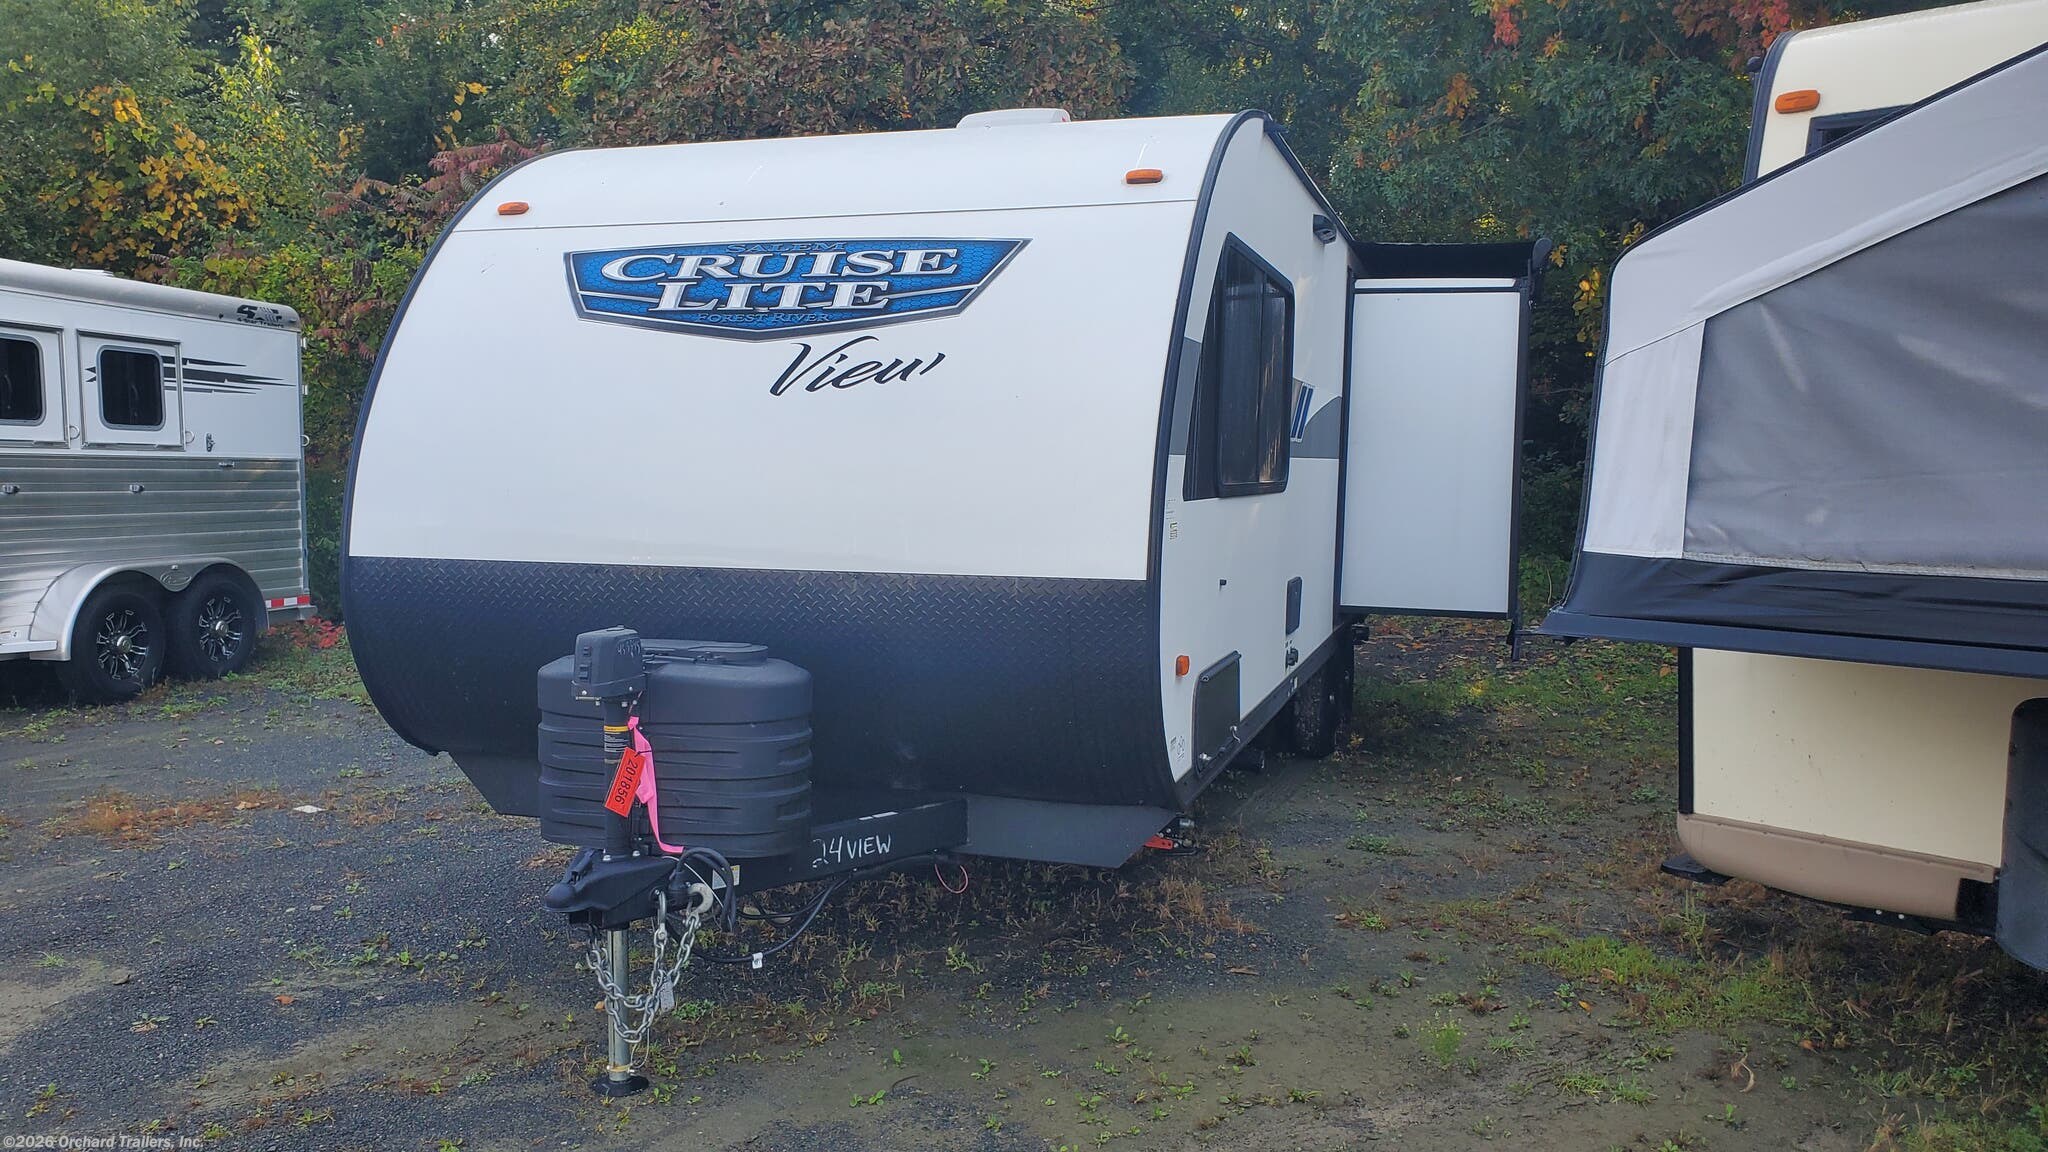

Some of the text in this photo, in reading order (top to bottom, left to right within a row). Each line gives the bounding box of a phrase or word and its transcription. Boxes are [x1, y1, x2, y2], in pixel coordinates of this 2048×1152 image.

[726, 242, 848, 253] SALEM
[602, 249, 958, 281] CRUISE
[649, 281, 889, 311] LITE
[772, 312, 831, 322] RIVER
[615, 757, 638, 804] 201856
